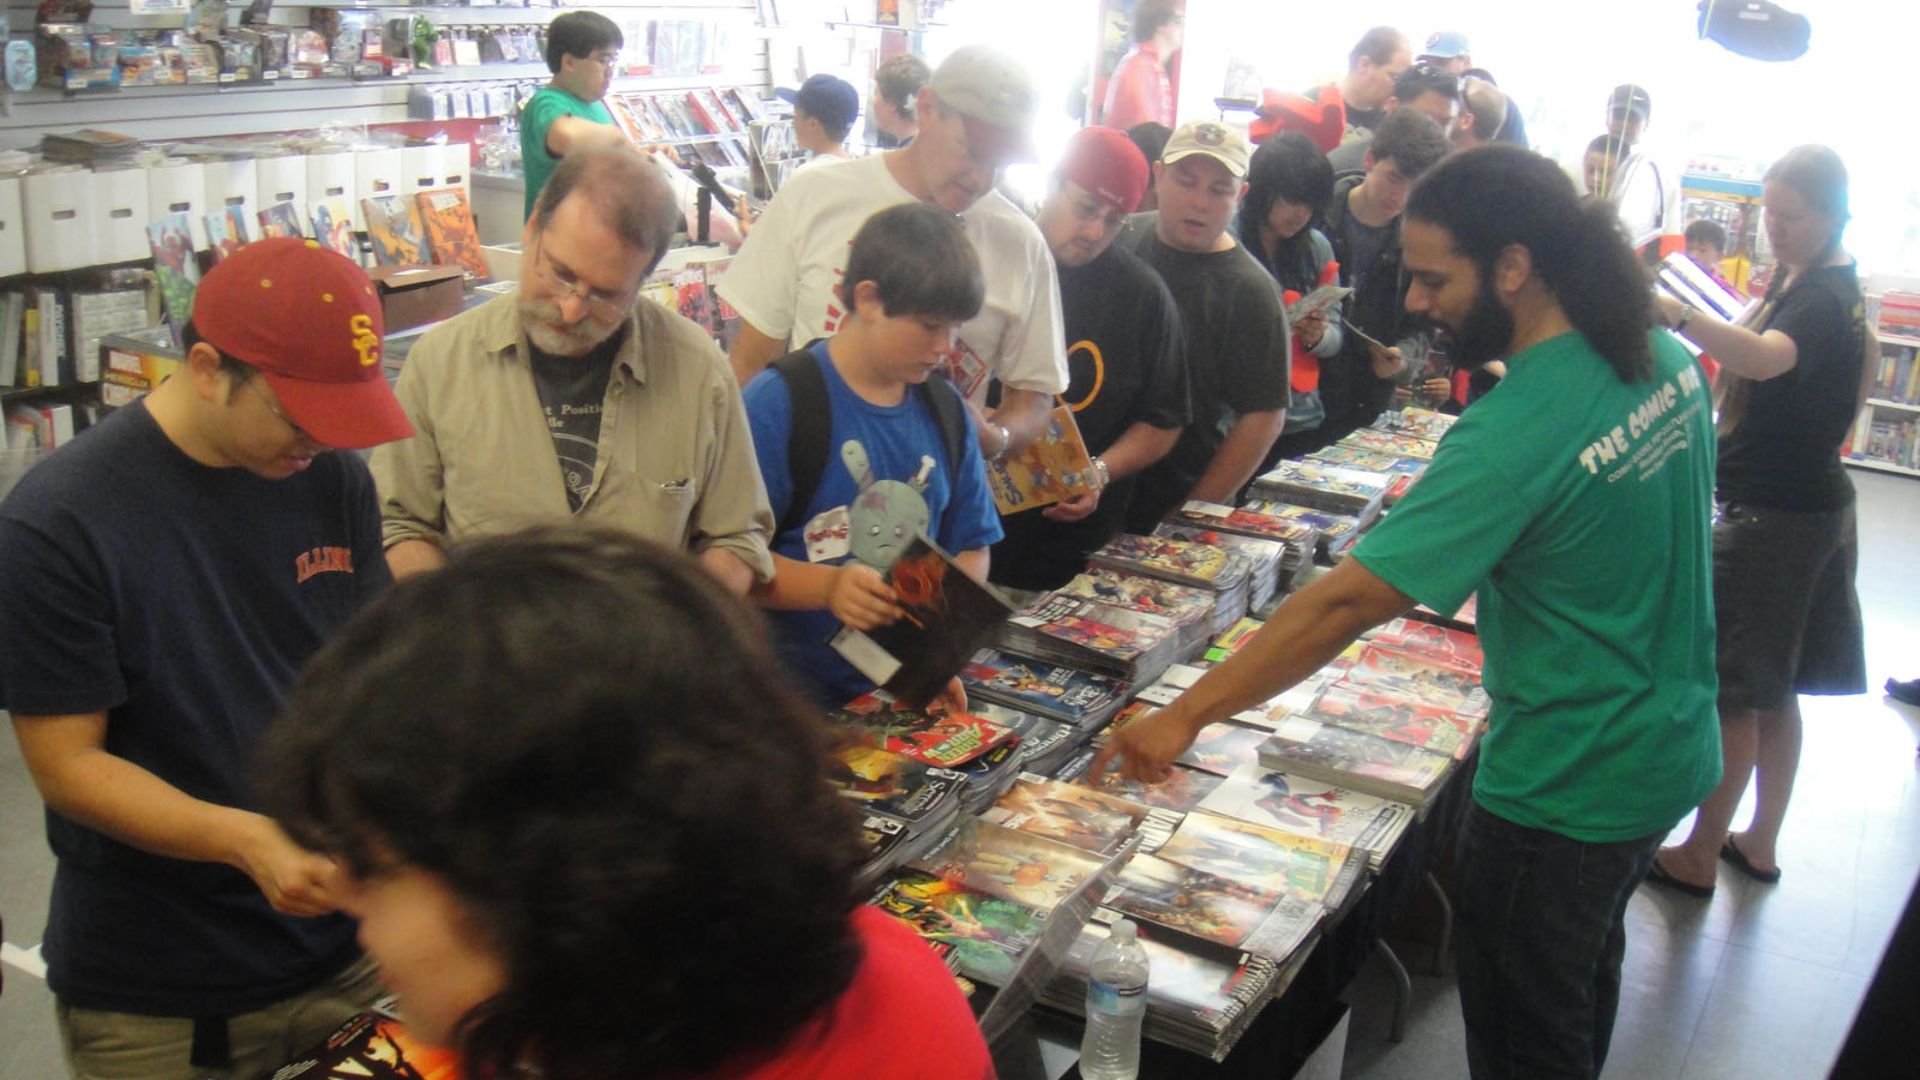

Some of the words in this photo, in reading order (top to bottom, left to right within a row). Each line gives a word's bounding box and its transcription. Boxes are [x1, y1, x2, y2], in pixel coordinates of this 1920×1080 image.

[561, 404, 602, 415] Positi
[1579, 425, 1629, 474] THE
[1628, 382, 1677, 440] COMIC
